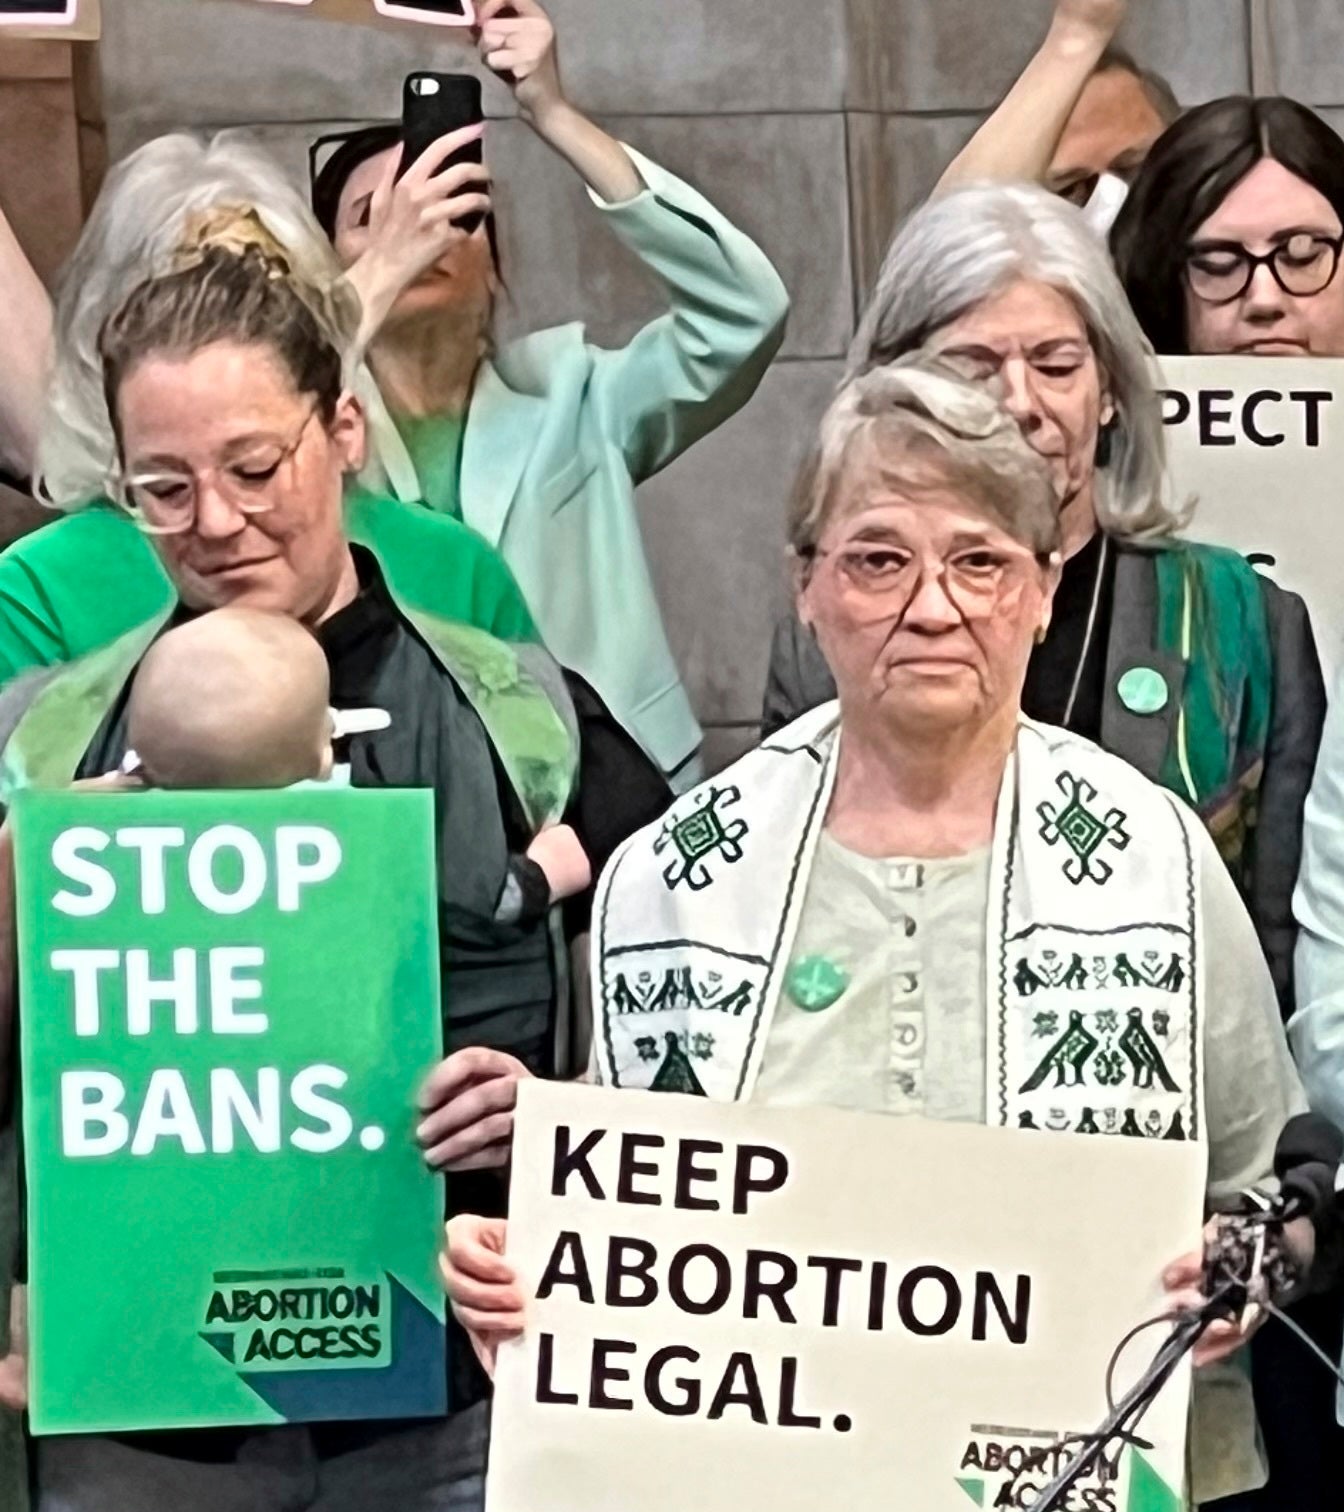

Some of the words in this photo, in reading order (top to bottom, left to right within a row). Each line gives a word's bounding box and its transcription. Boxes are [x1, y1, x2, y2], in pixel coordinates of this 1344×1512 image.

[51, 823, 343, 917] STOP
[50, 946, 270, 1037] THE
[61, 1064, 386, 1158] BANS.
[551, 1125, 790, 1215] KEEP
[205, 1284, 381, 1324] ABORTION
[535, 1230, 1032, 1345] ABORTION
[243, 1324, 382, 1363] ACCESS
[536, 1332, 853, 1433] LEGAL.
